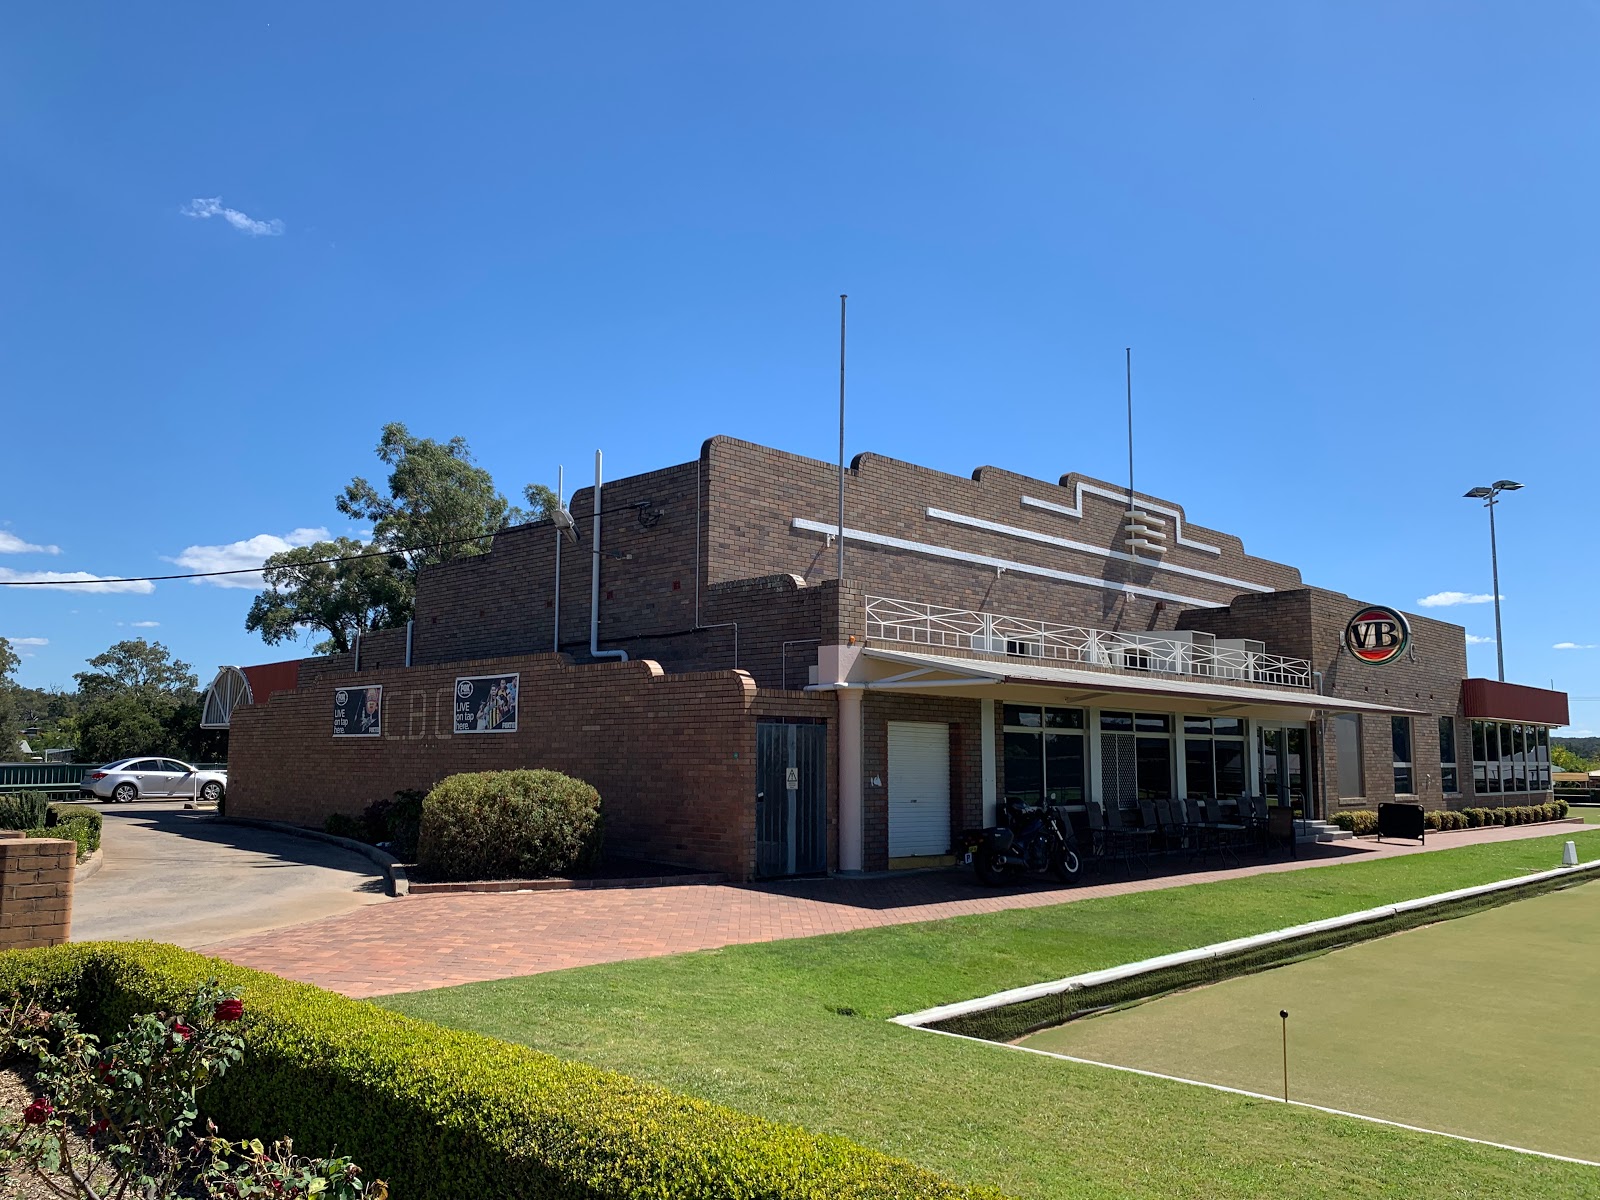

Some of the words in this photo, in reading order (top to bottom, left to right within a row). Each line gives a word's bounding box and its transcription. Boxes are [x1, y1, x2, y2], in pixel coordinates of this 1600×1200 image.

[1351, 622, 1398, 648] VB
[457, 702, 470, 711] LIVE
[335, 709, 345, 717] LIVE
[464, 712, 474, 722] tap
